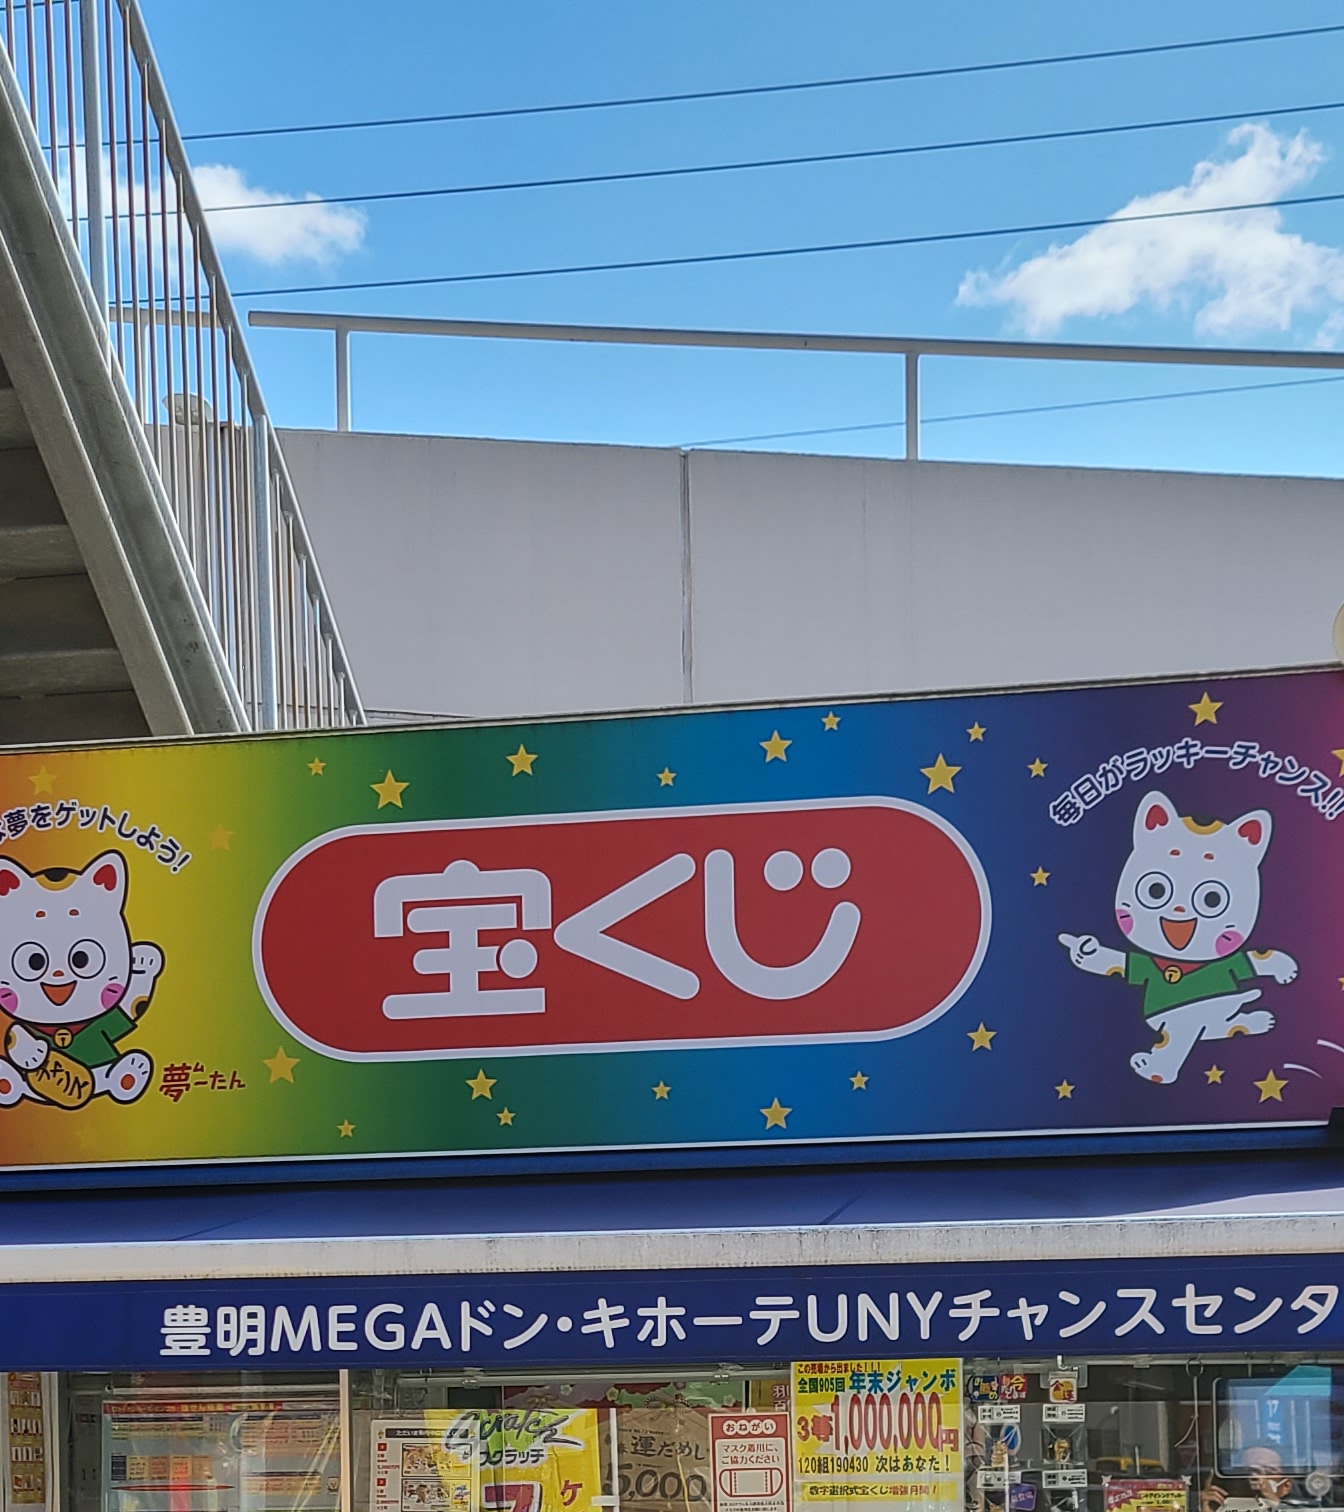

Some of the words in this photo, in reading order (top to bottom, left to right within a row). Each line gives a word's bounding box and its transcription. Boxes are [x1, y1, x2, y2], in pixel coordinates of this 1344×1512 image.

[372, 846, 862, 1022] 宝くじ
[849, 1368, 957, 1395] 年末ジャンボ
[725, 1421, 775, 1433] おねがい
[830, 1391, 960, 1455] 1,000,000円
[721, 1454, 780, 1465] ご協力ください
